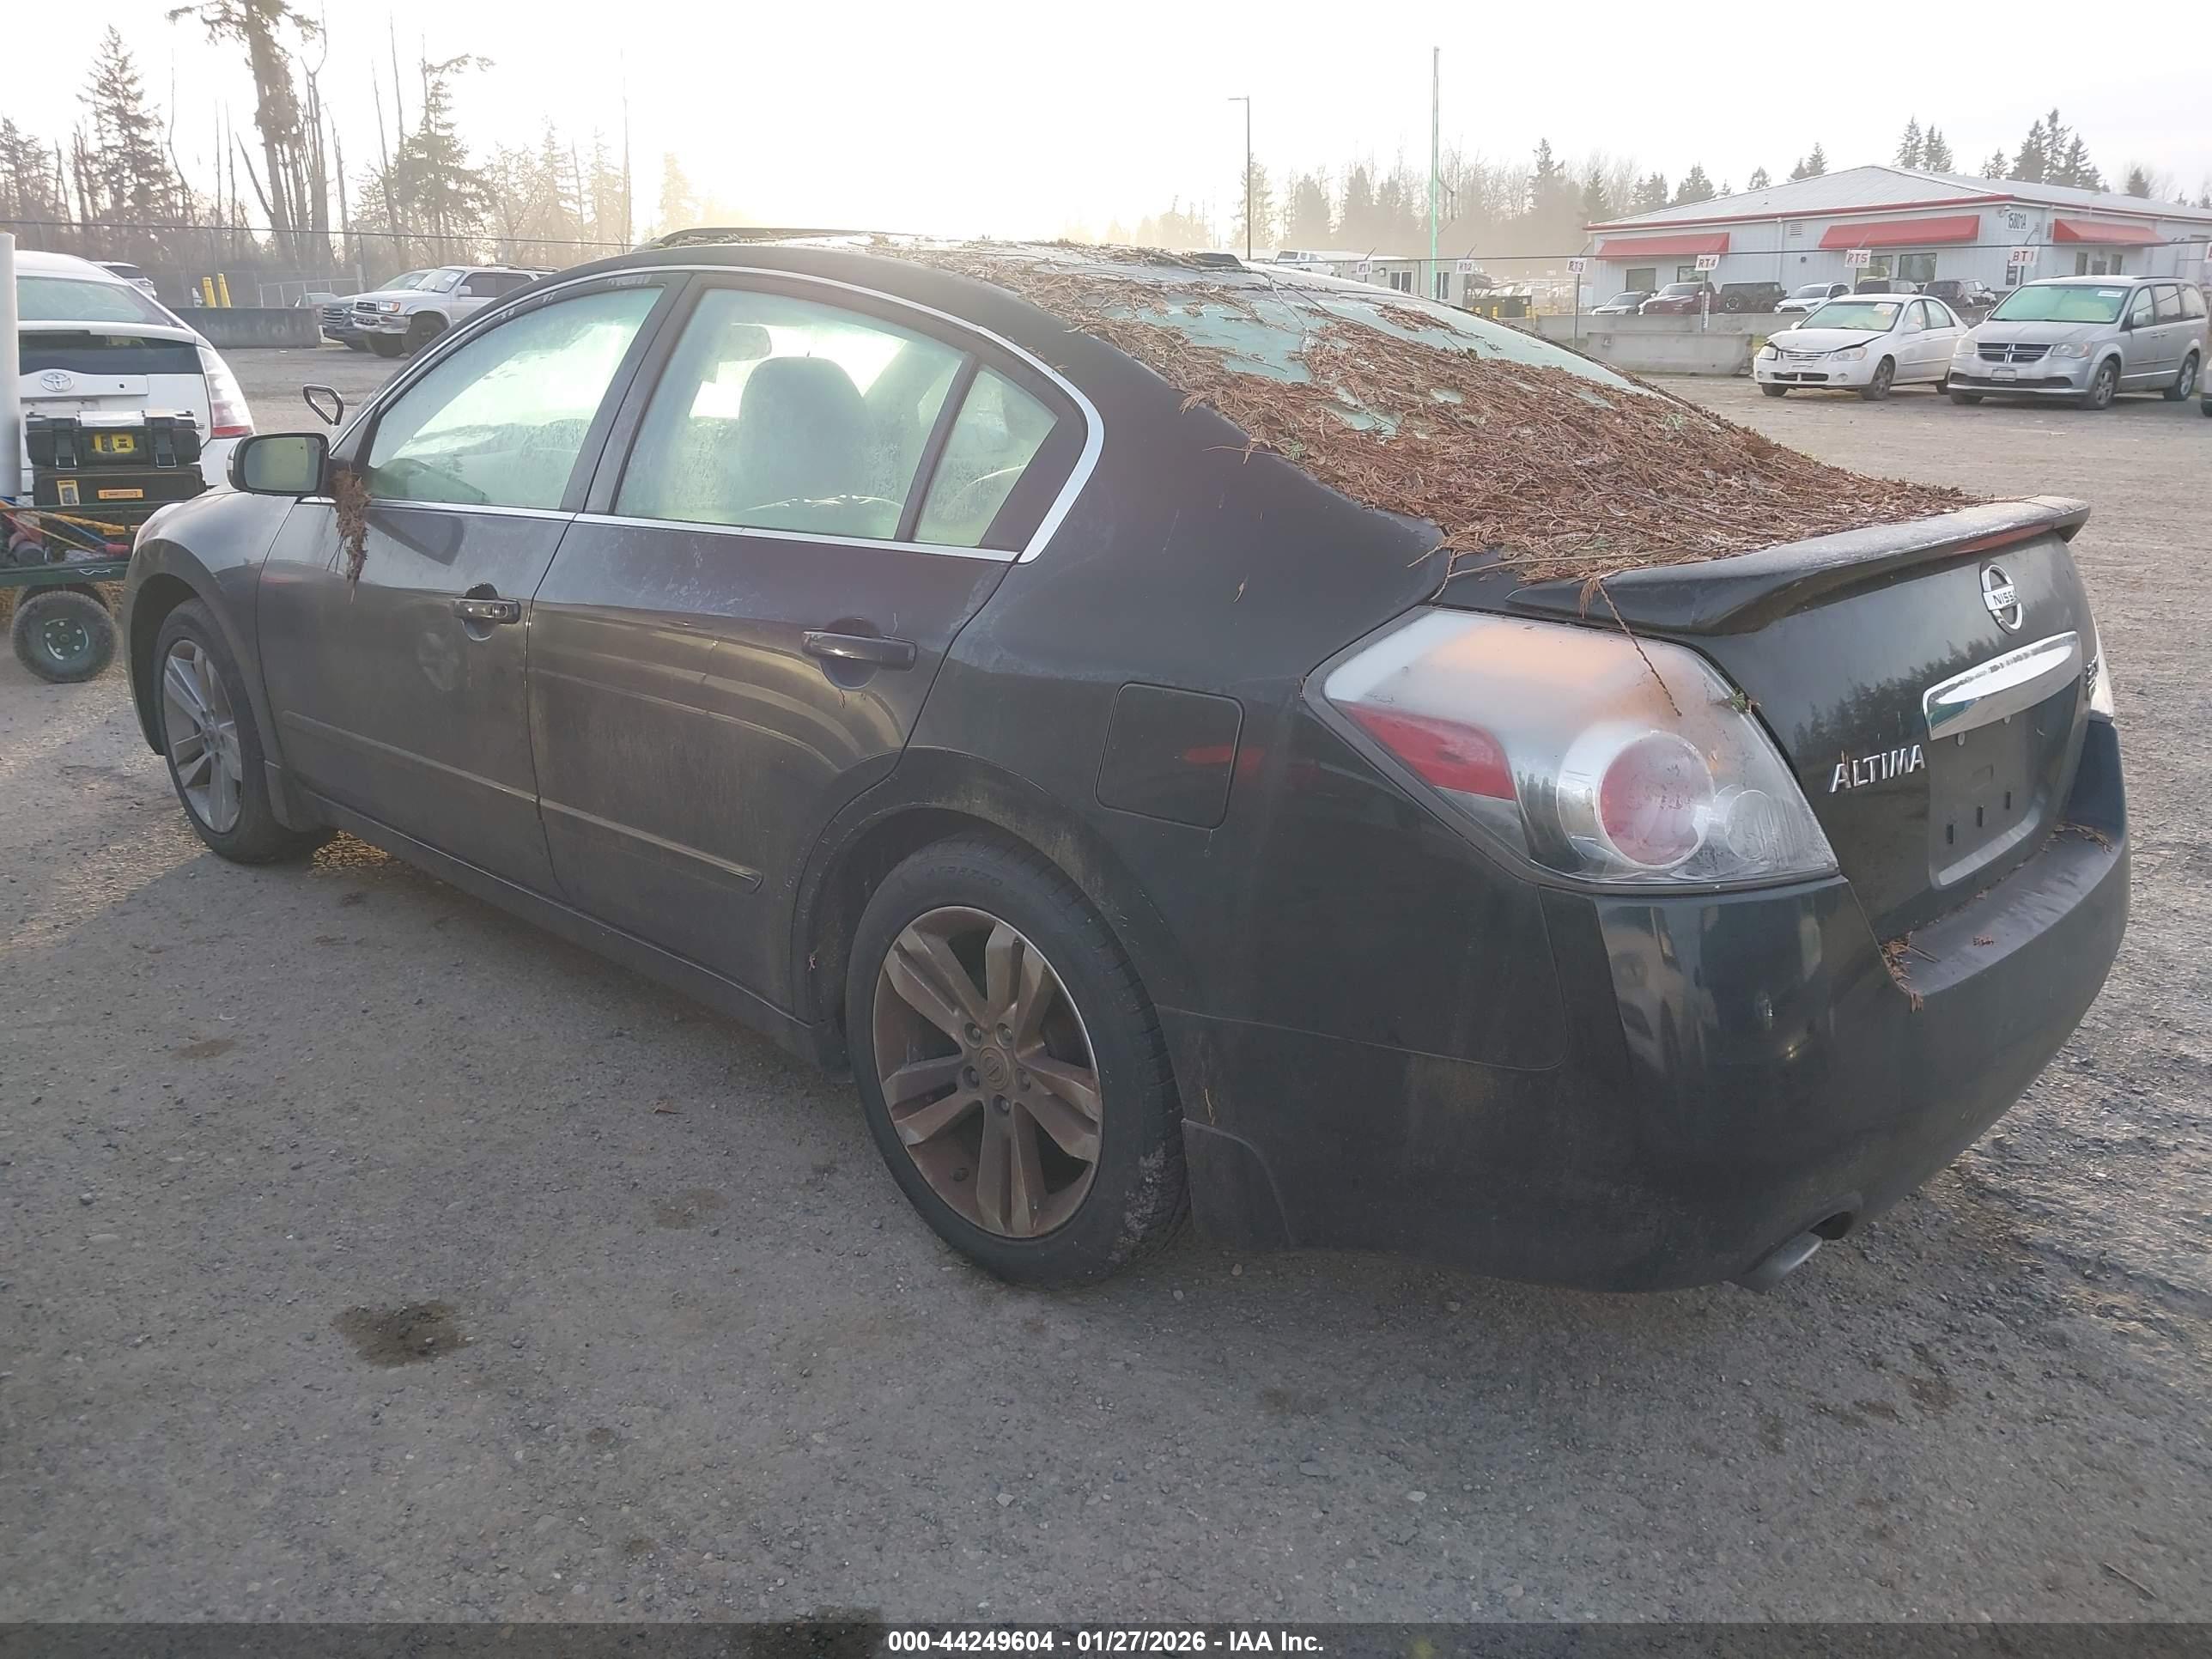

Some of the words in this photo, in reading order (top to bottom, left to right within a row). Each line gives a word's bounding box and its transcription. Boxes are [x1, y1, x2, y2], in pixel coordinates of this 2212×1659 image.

[1698, 258, 1717, 269] RT4
[1847, 253, 1869, 264] RT5
[1568, 260, 1583, 271] RT3
[1992, 589, 2017, 606] NISS
[1829, 744, 1925, 793] ALTIMA
